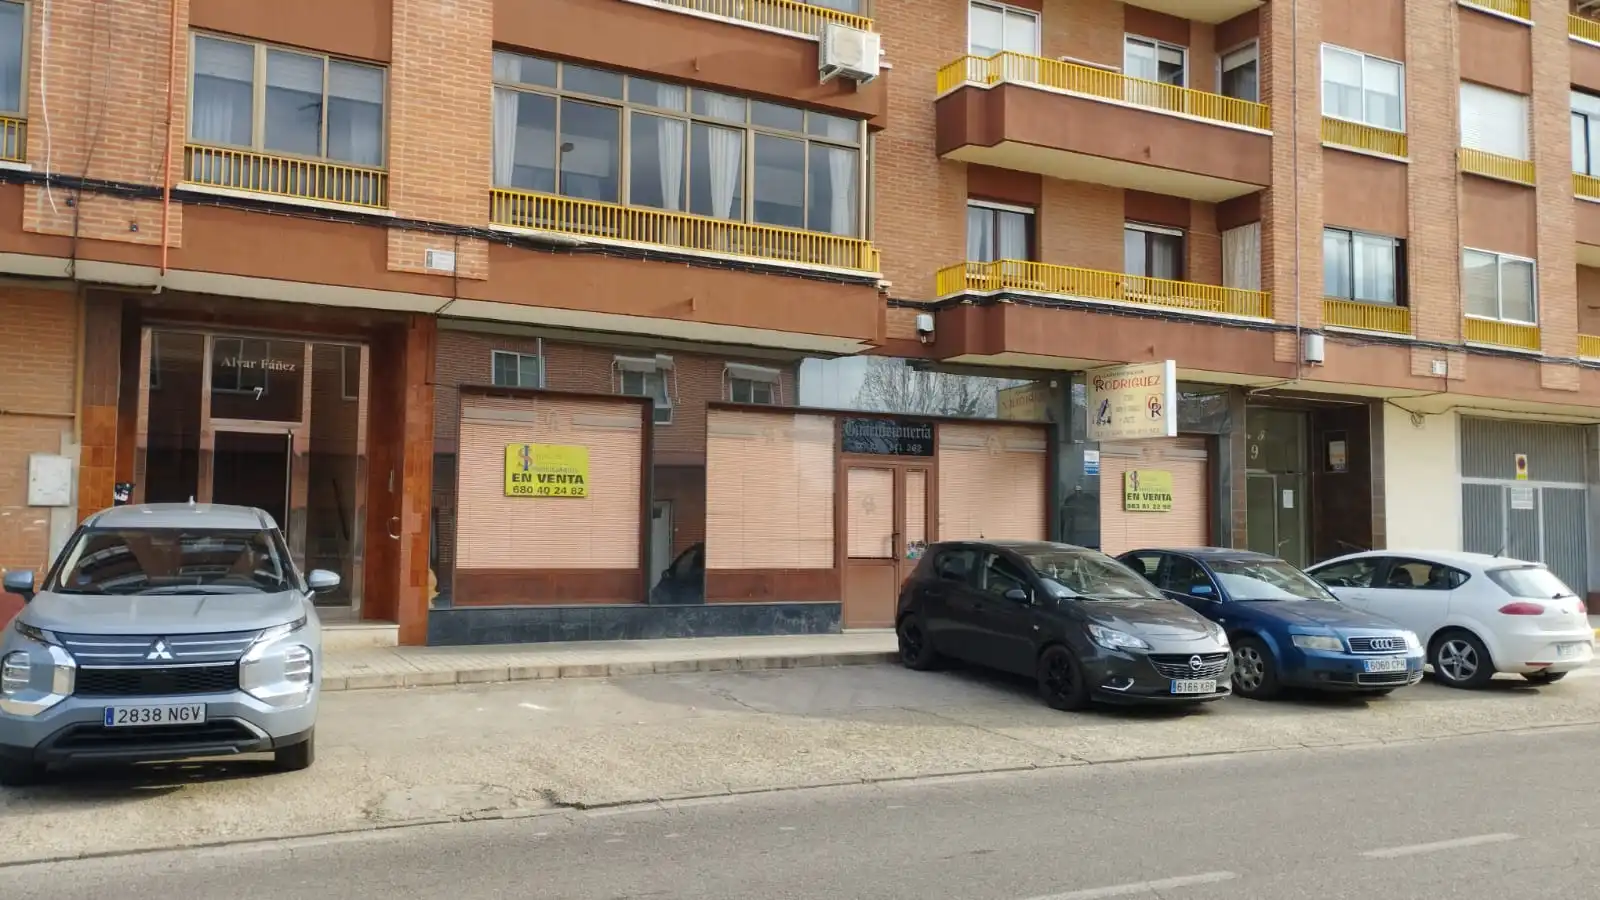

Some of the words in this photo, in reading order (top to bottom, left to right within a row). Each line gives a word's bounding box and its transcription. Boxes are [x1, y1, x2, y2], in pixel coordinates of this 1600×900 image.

[221, 357, 257, 369] Alvar
[261, 359, 296, 372] Fáñez
[253, 386, 264, 401] 7
[1250, 444, 1259, 460] 9
[512, 473, 532, 483] EN
[537, 474, 585, 485] VENTA
[513, 485, 534, 494] 680
[537, 486, 551, 495] 40
[554, 486, 567, 495] 24
[1127, 493, 1140, 501] EN
[1143, 493, 1172, 501] VENTA
[118, 708, 162, 723] 2838
[168, 706, 201, 721] NGV
